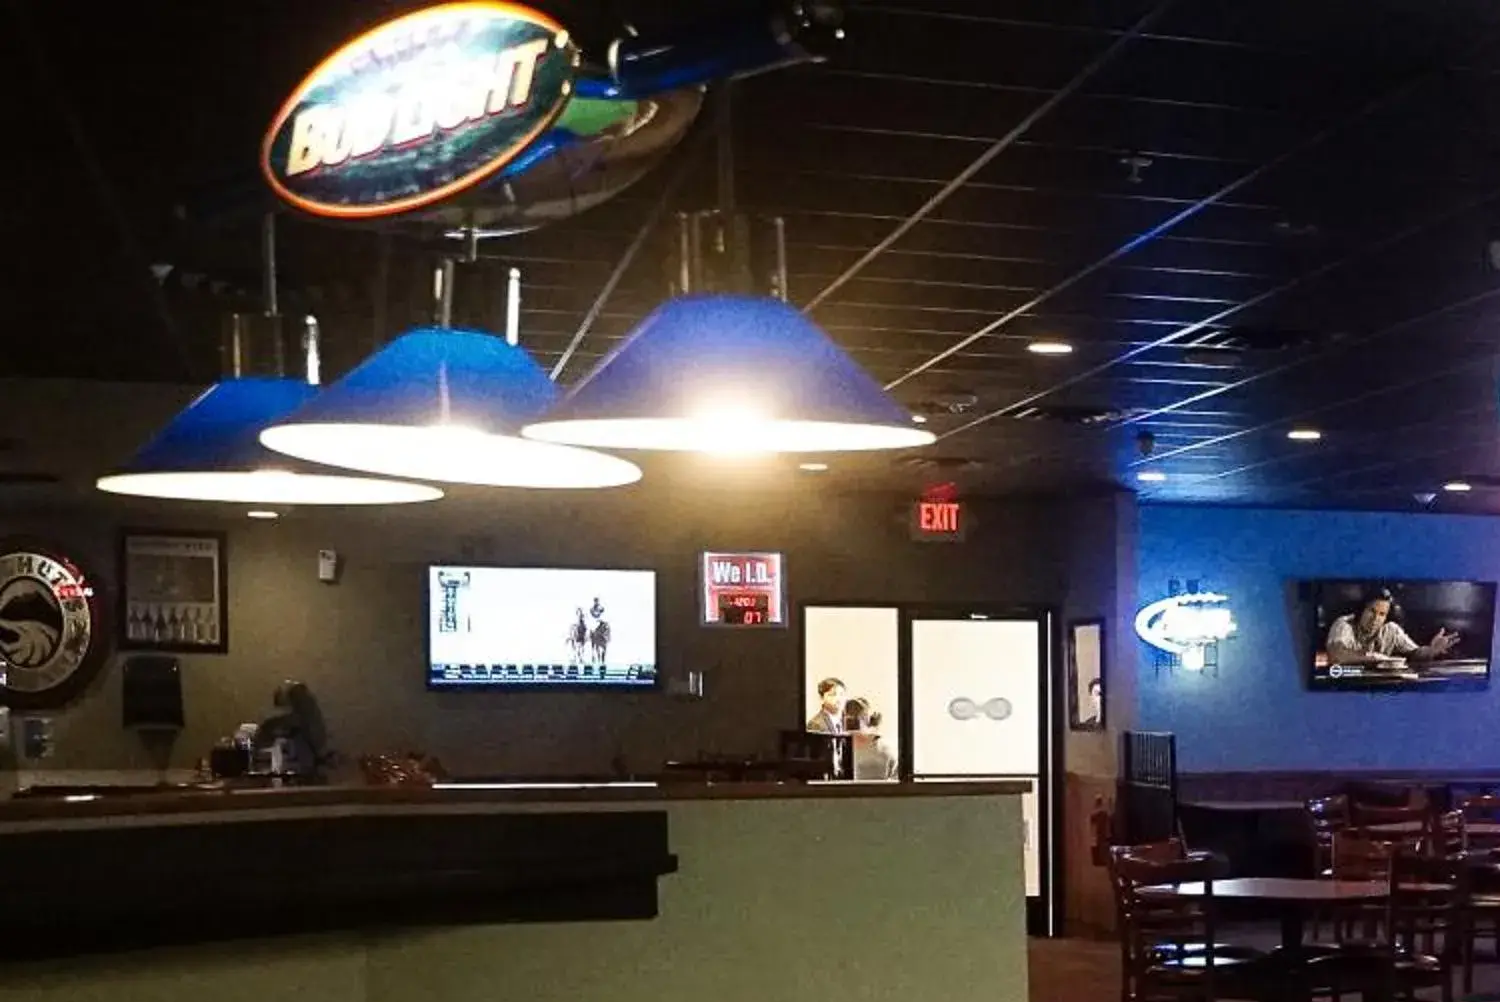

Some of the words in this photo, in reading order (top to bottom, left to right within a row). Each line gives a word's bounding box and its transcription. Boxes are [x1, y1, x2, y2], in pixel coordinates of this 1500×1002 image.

[286, 82, 400, 176] BUD
[389, 38, 549, 150] LIGHT
[920, 502, 959, 531] EXIT
[712, 561, 741, 583] We
